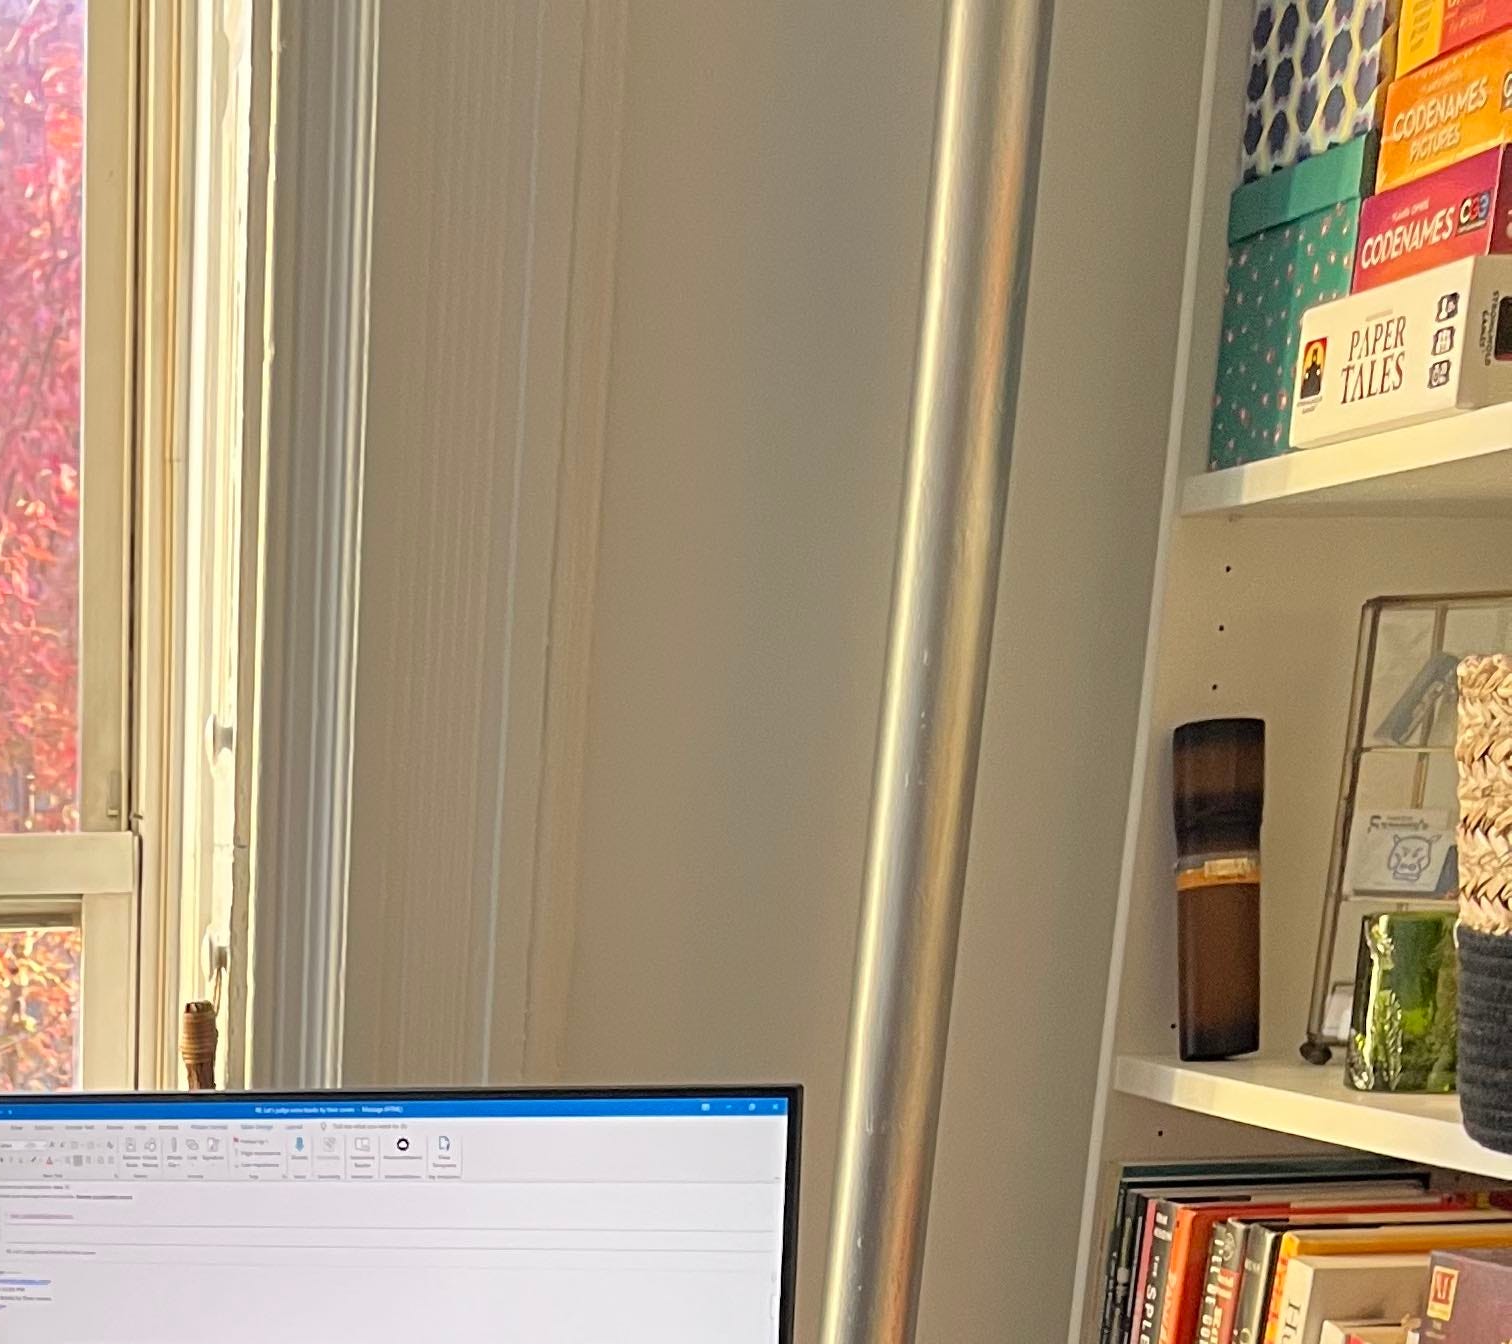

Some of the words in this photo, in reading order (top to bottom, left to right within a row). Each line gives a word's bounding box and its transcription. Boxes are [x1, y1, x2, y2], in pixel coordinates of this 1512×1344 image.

[1392, 77, 1487, 142] CODENAMES
[1410, 122, 1460, 164] PICTURES
[1361, 207, 1455, 269] CODENAMES
[1348, 315, 1406, 362] PAPER
[1341, 351, 1405, 404] TALES
[1204, 1283, 1218, 1308] BE
